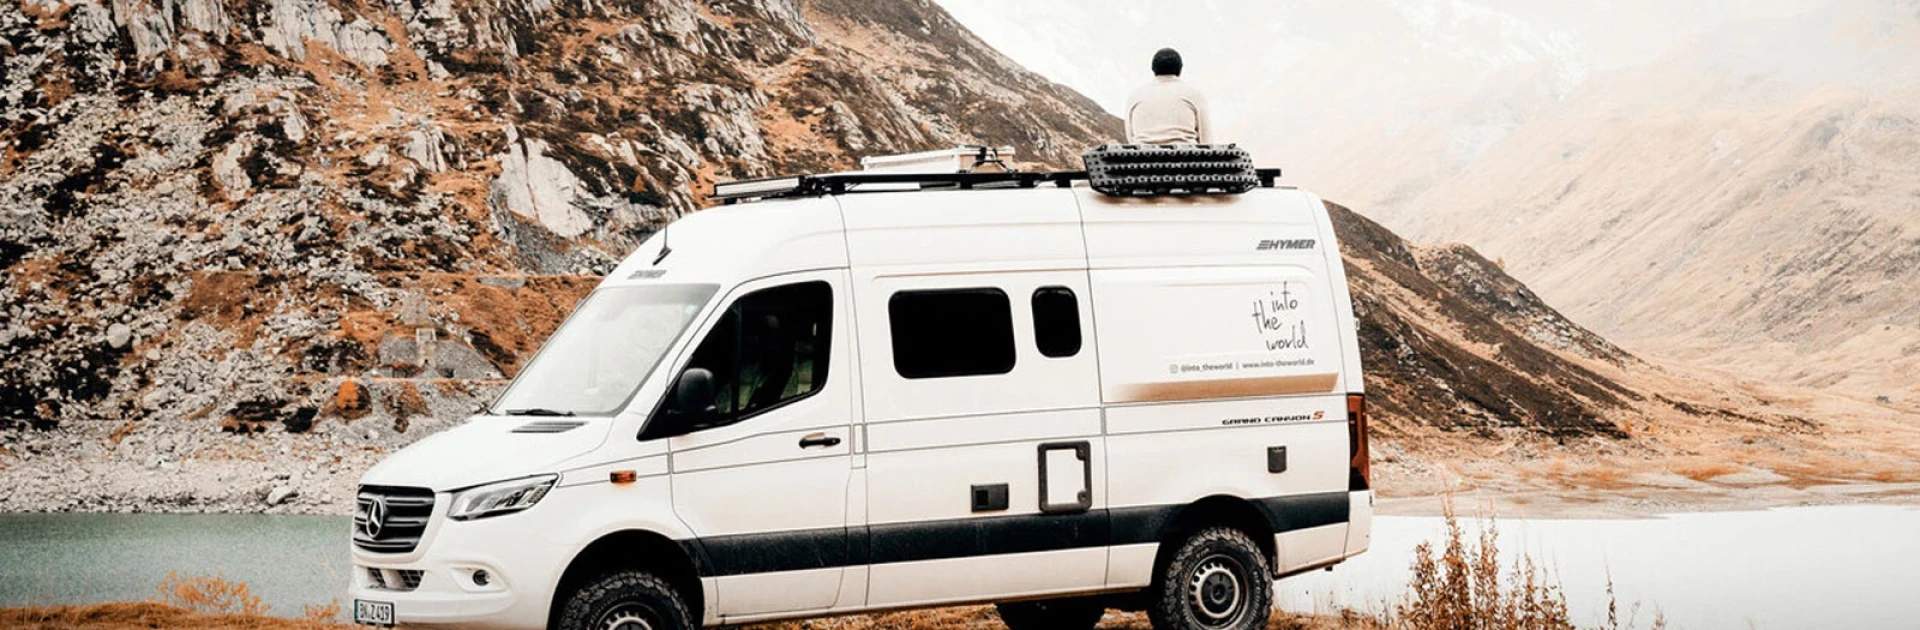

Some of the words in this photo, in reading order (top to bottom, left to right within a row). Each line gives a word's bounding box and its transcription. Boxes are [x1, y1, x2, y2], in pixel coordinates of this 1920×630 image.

[1268, 239, 1316, 250] HYMER
[1270, 281, 1298, 312] into
[1252, 299, 1283, 334] the
[1265, 319, 1309, 351] world
[1222, 417, 1261, 425] GRAND
[1264, 414, 1311, 422] CANYON
[1313, 410, 1325, 420] S
